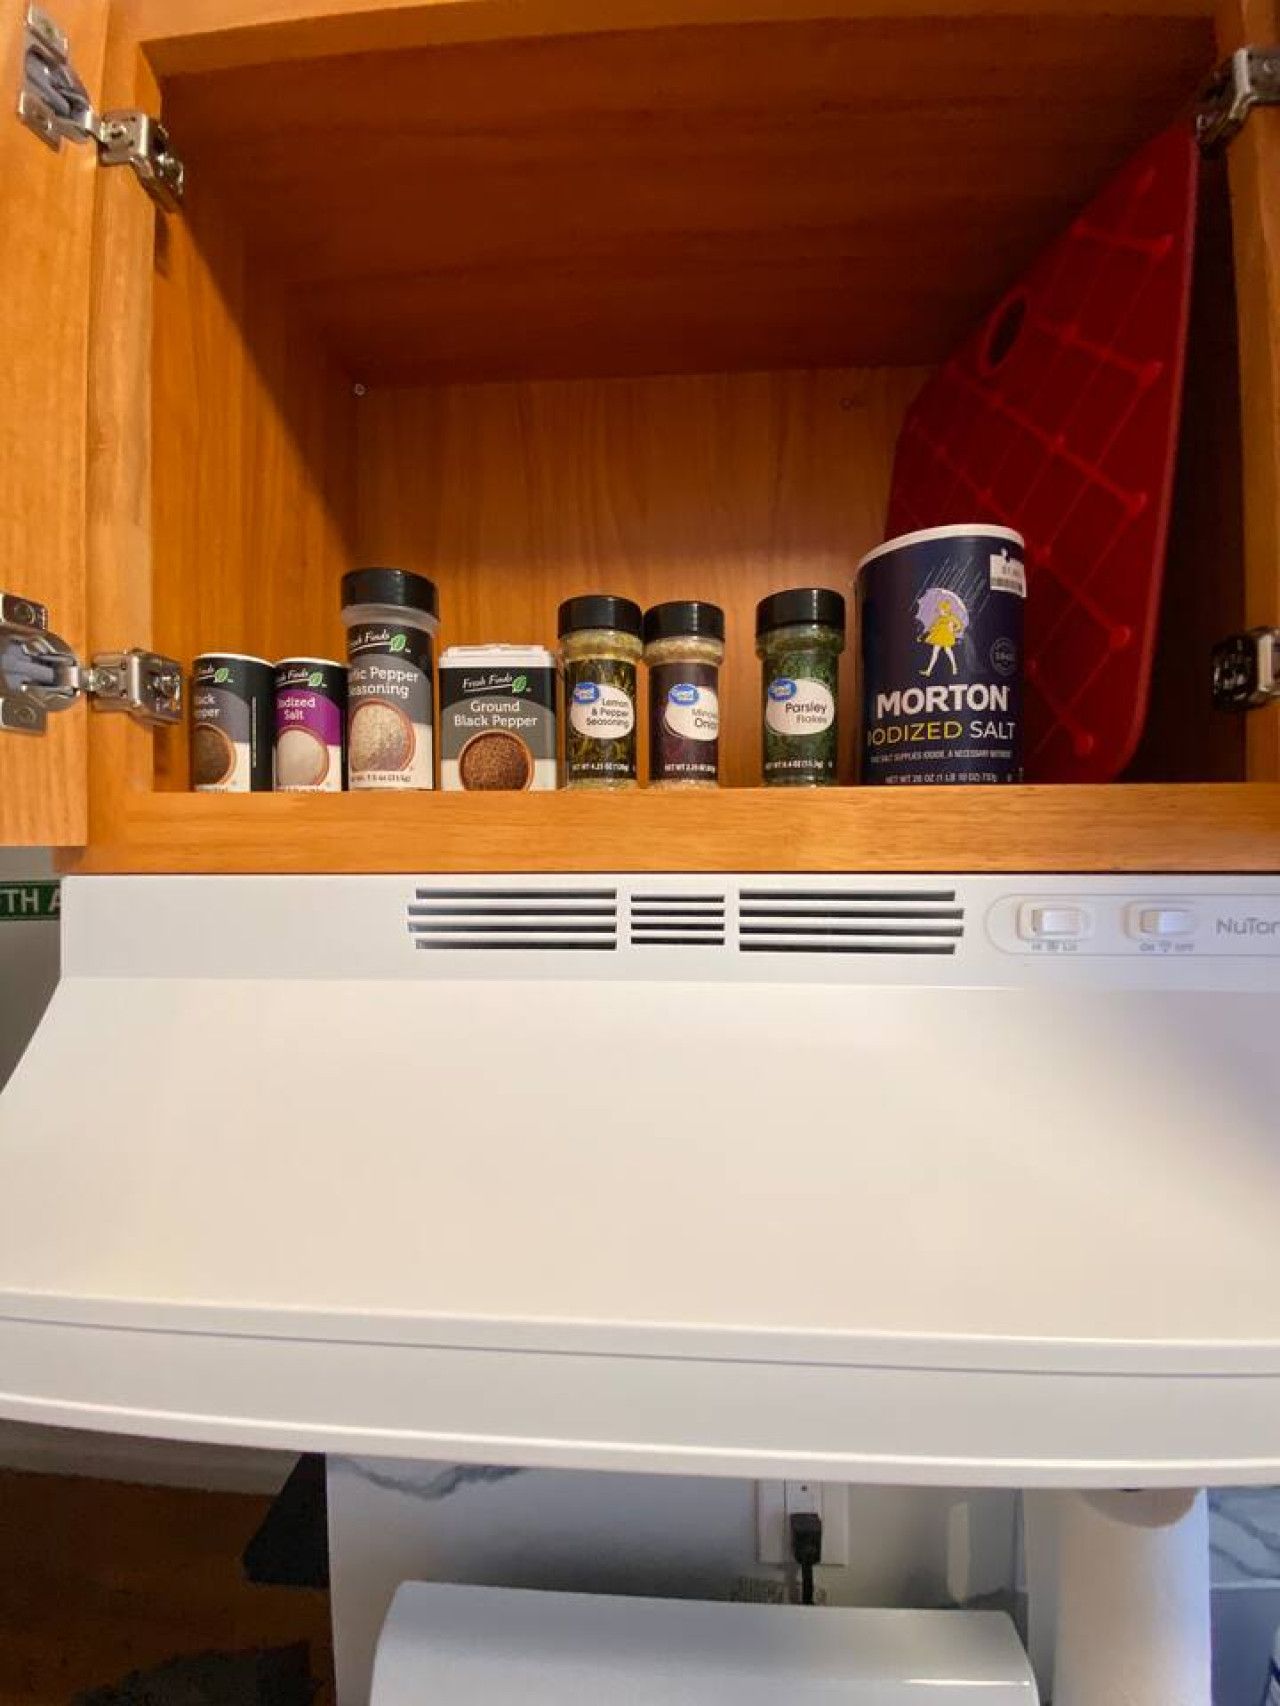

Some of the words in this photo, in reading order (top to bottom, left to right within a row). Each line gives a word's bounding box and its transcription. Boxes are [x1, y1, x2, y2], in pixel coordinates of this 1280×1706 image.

[369, 665, 419, 684] Pepper
[470, 699, 520, 712] Ground
[785, 701, 828, 715] Parsley
[876, 684, 1008, 719] MORTON
[284, 707, 305, 721] Salt
[600, 707, 630, 719] Pepper
[454, 714, 489, 727] Black
[492, 714, 538, 729] Pepper
[586, 716, 630, 730] Seasoning
[969, 720, 1016, 740] SALT
